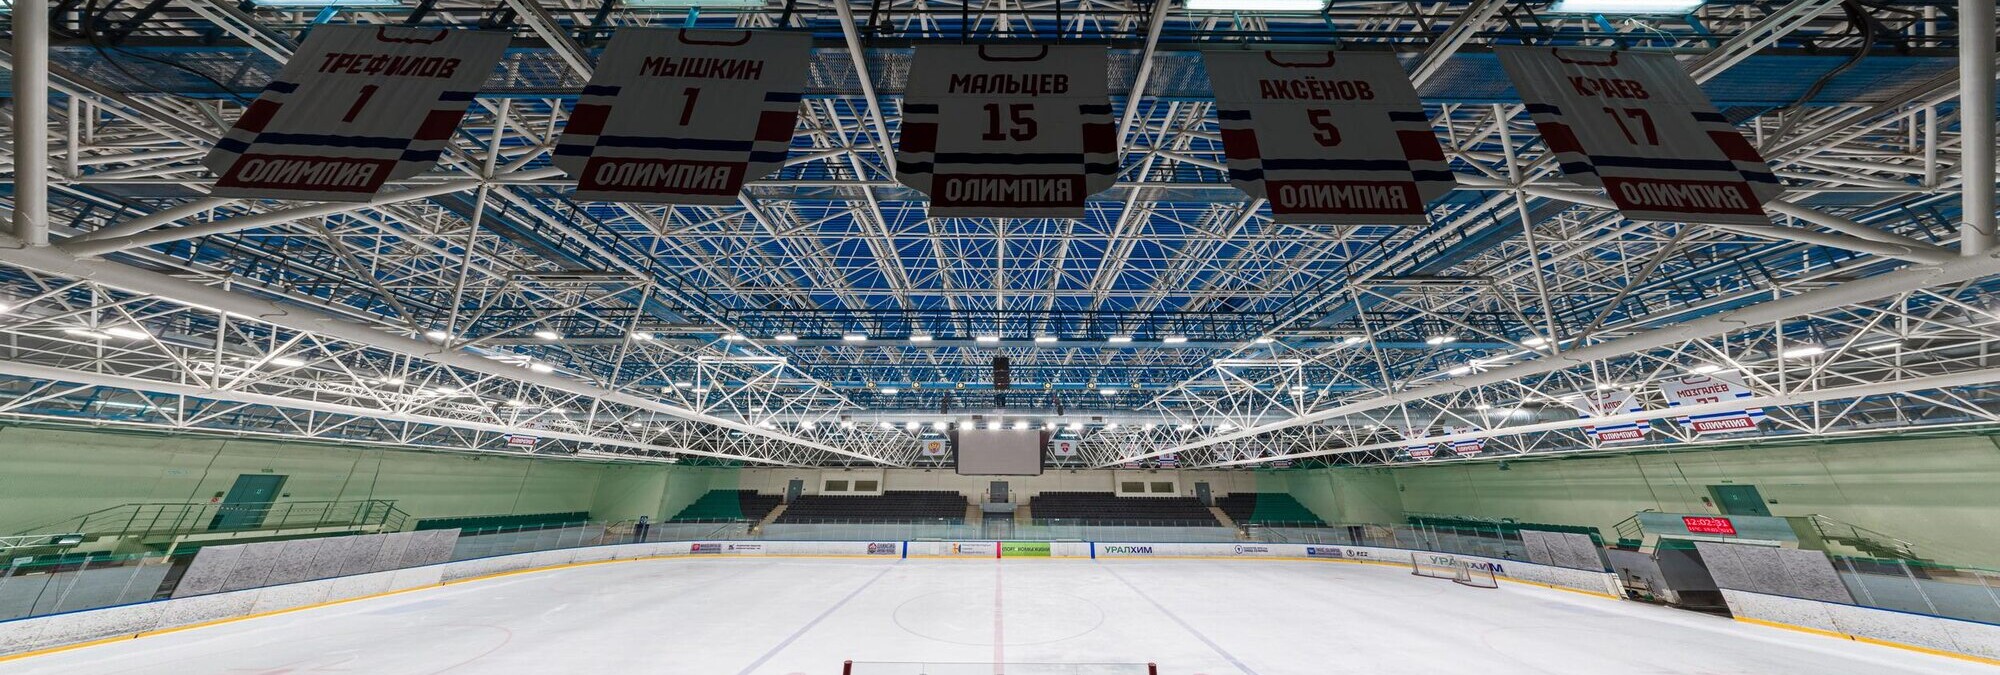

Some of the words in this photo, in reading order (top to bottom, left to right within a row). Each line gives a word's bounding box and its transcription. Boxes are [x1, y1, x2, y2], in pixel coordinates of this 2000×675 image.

[318, 52, 461, 78] ТРЕФИЛОВ
[639, 56, 764, 80] МЫШКИН
[948, 74, 1069, 97] МАЛЬЦЕВ
[1259, 75, 1376, 101] АКСЁНОВ
[1567, 76, 1650, 100] КРАЕВ
[342, 84, 379, 123] 1
[679, 87, 701, 126] 1
[982, 103, 1038, 142] 15
[1307, 108, 1342, 147] 5
[1603, 107, 1659, 145] 17
[236, 158, 379, 188] ОЛИМПИЯ
[594, 162, 730, 190] ОЛИМПИЯ
[945, 178, 1072, 202] ОЛИМПИЯ
[1279, 184, 1408, 210] ОЛИМПИЯ
[1622, 182, 1747, 209] ОЛИМПИЯ
[1676, 383, 1730, 398] МОЗГАЛЁВ
[1602, 430, 1639, 441] ОЛИМПИЯ
[1698, 419, 1749, 431] ОЛИМПИЯ
[1686, 518, 1728, 527] 12:02:31
[1105, 546, 1153, 554] УРАЛХИМ
